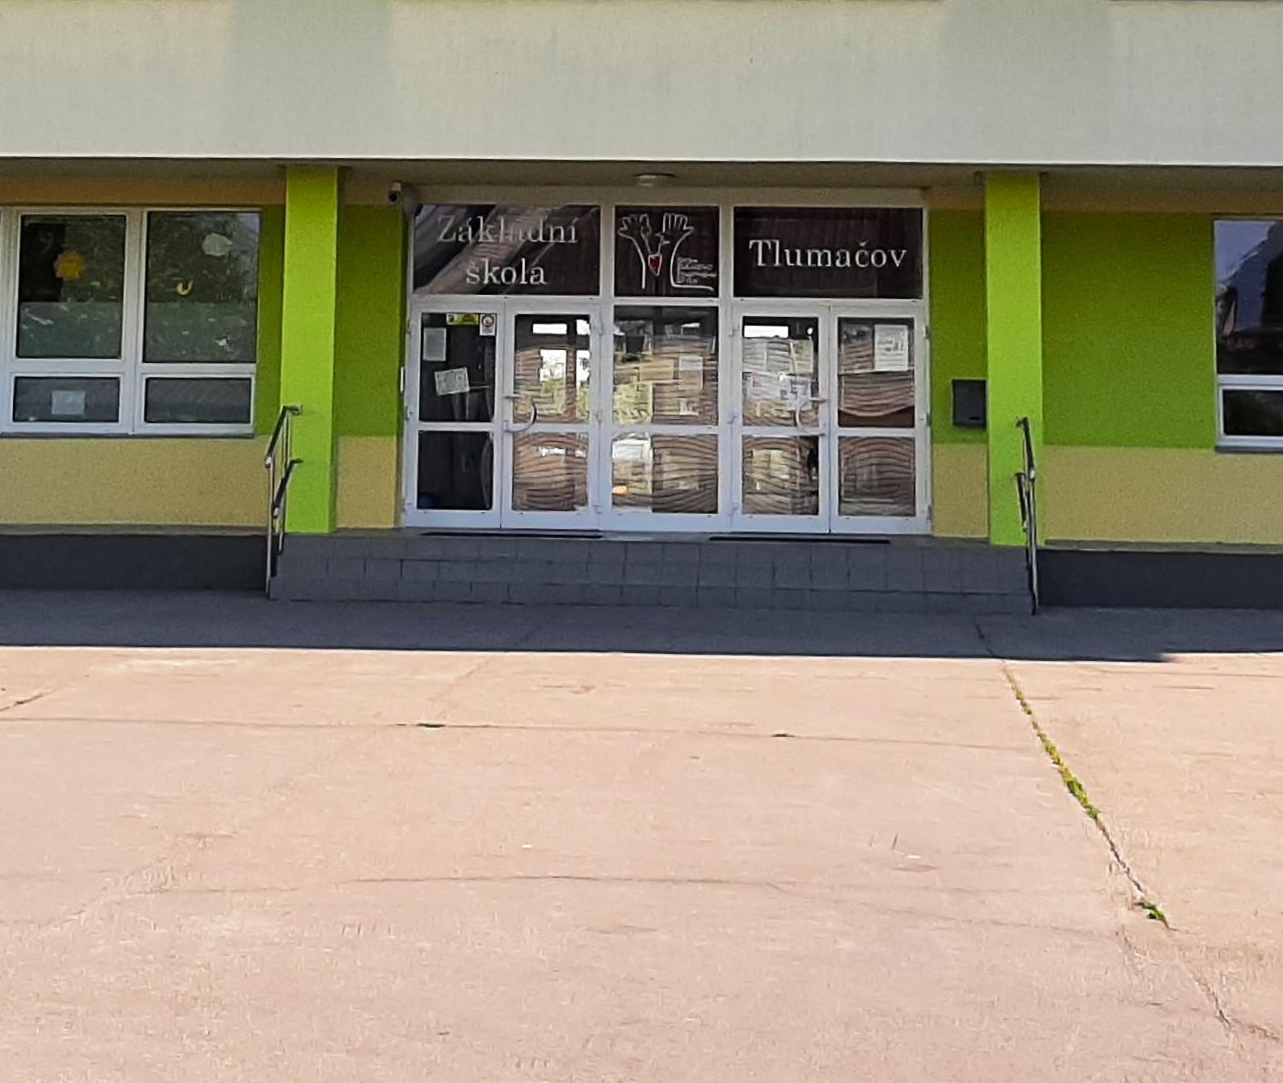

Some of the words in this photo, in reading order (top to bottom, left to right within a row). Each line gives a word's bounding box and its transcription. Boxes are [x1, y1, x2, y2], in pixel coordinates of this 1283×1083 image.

[436, 215, 578, 244] Základní
[748, 239, 907, 268] Tlumačov
[465, 257, 547, 286] škola
